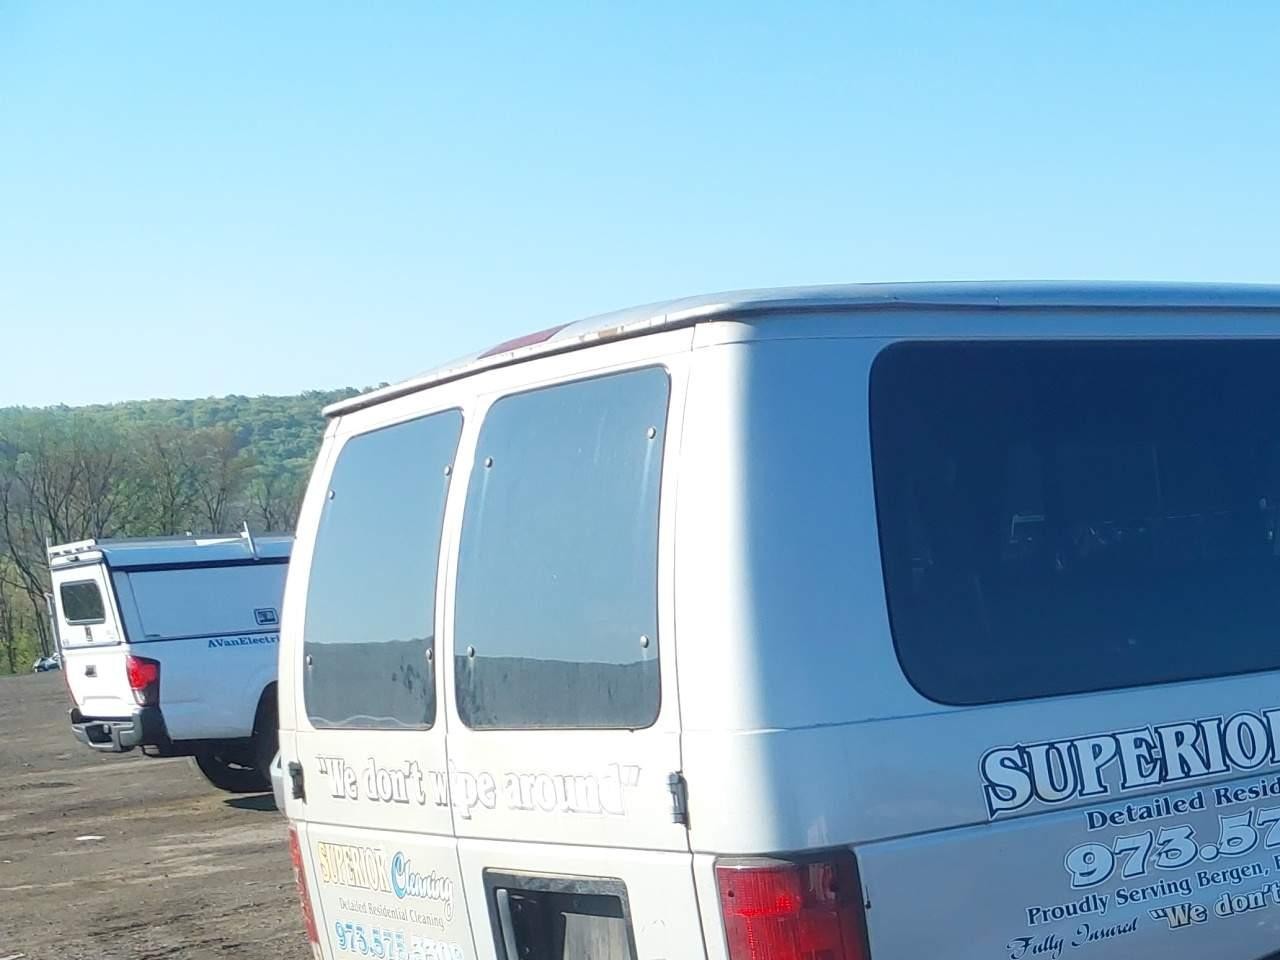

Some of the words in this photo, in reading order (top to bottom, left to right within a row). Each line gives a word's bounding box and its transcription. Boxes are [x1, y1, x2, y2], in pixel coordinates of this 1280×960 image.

[428, 758, 497, 820] wipe
[1085, 790, 1205, 831] Detailed
[318, 842, 392, 894] SUPERIOR
[391, 851, 454, 922] Cleaning
[1025, 893, 1108, 927] Proudly
[1115, 878, 1192, 907] Serving
[1196, 862, 1270, 888] Bergen,
[368, 901, 408, 921] Residential
[409, 909, 445, 931] Cleaning
[1006, 934, 1064, 960] Fully
[1071, 917, 1138, 948] Insured
